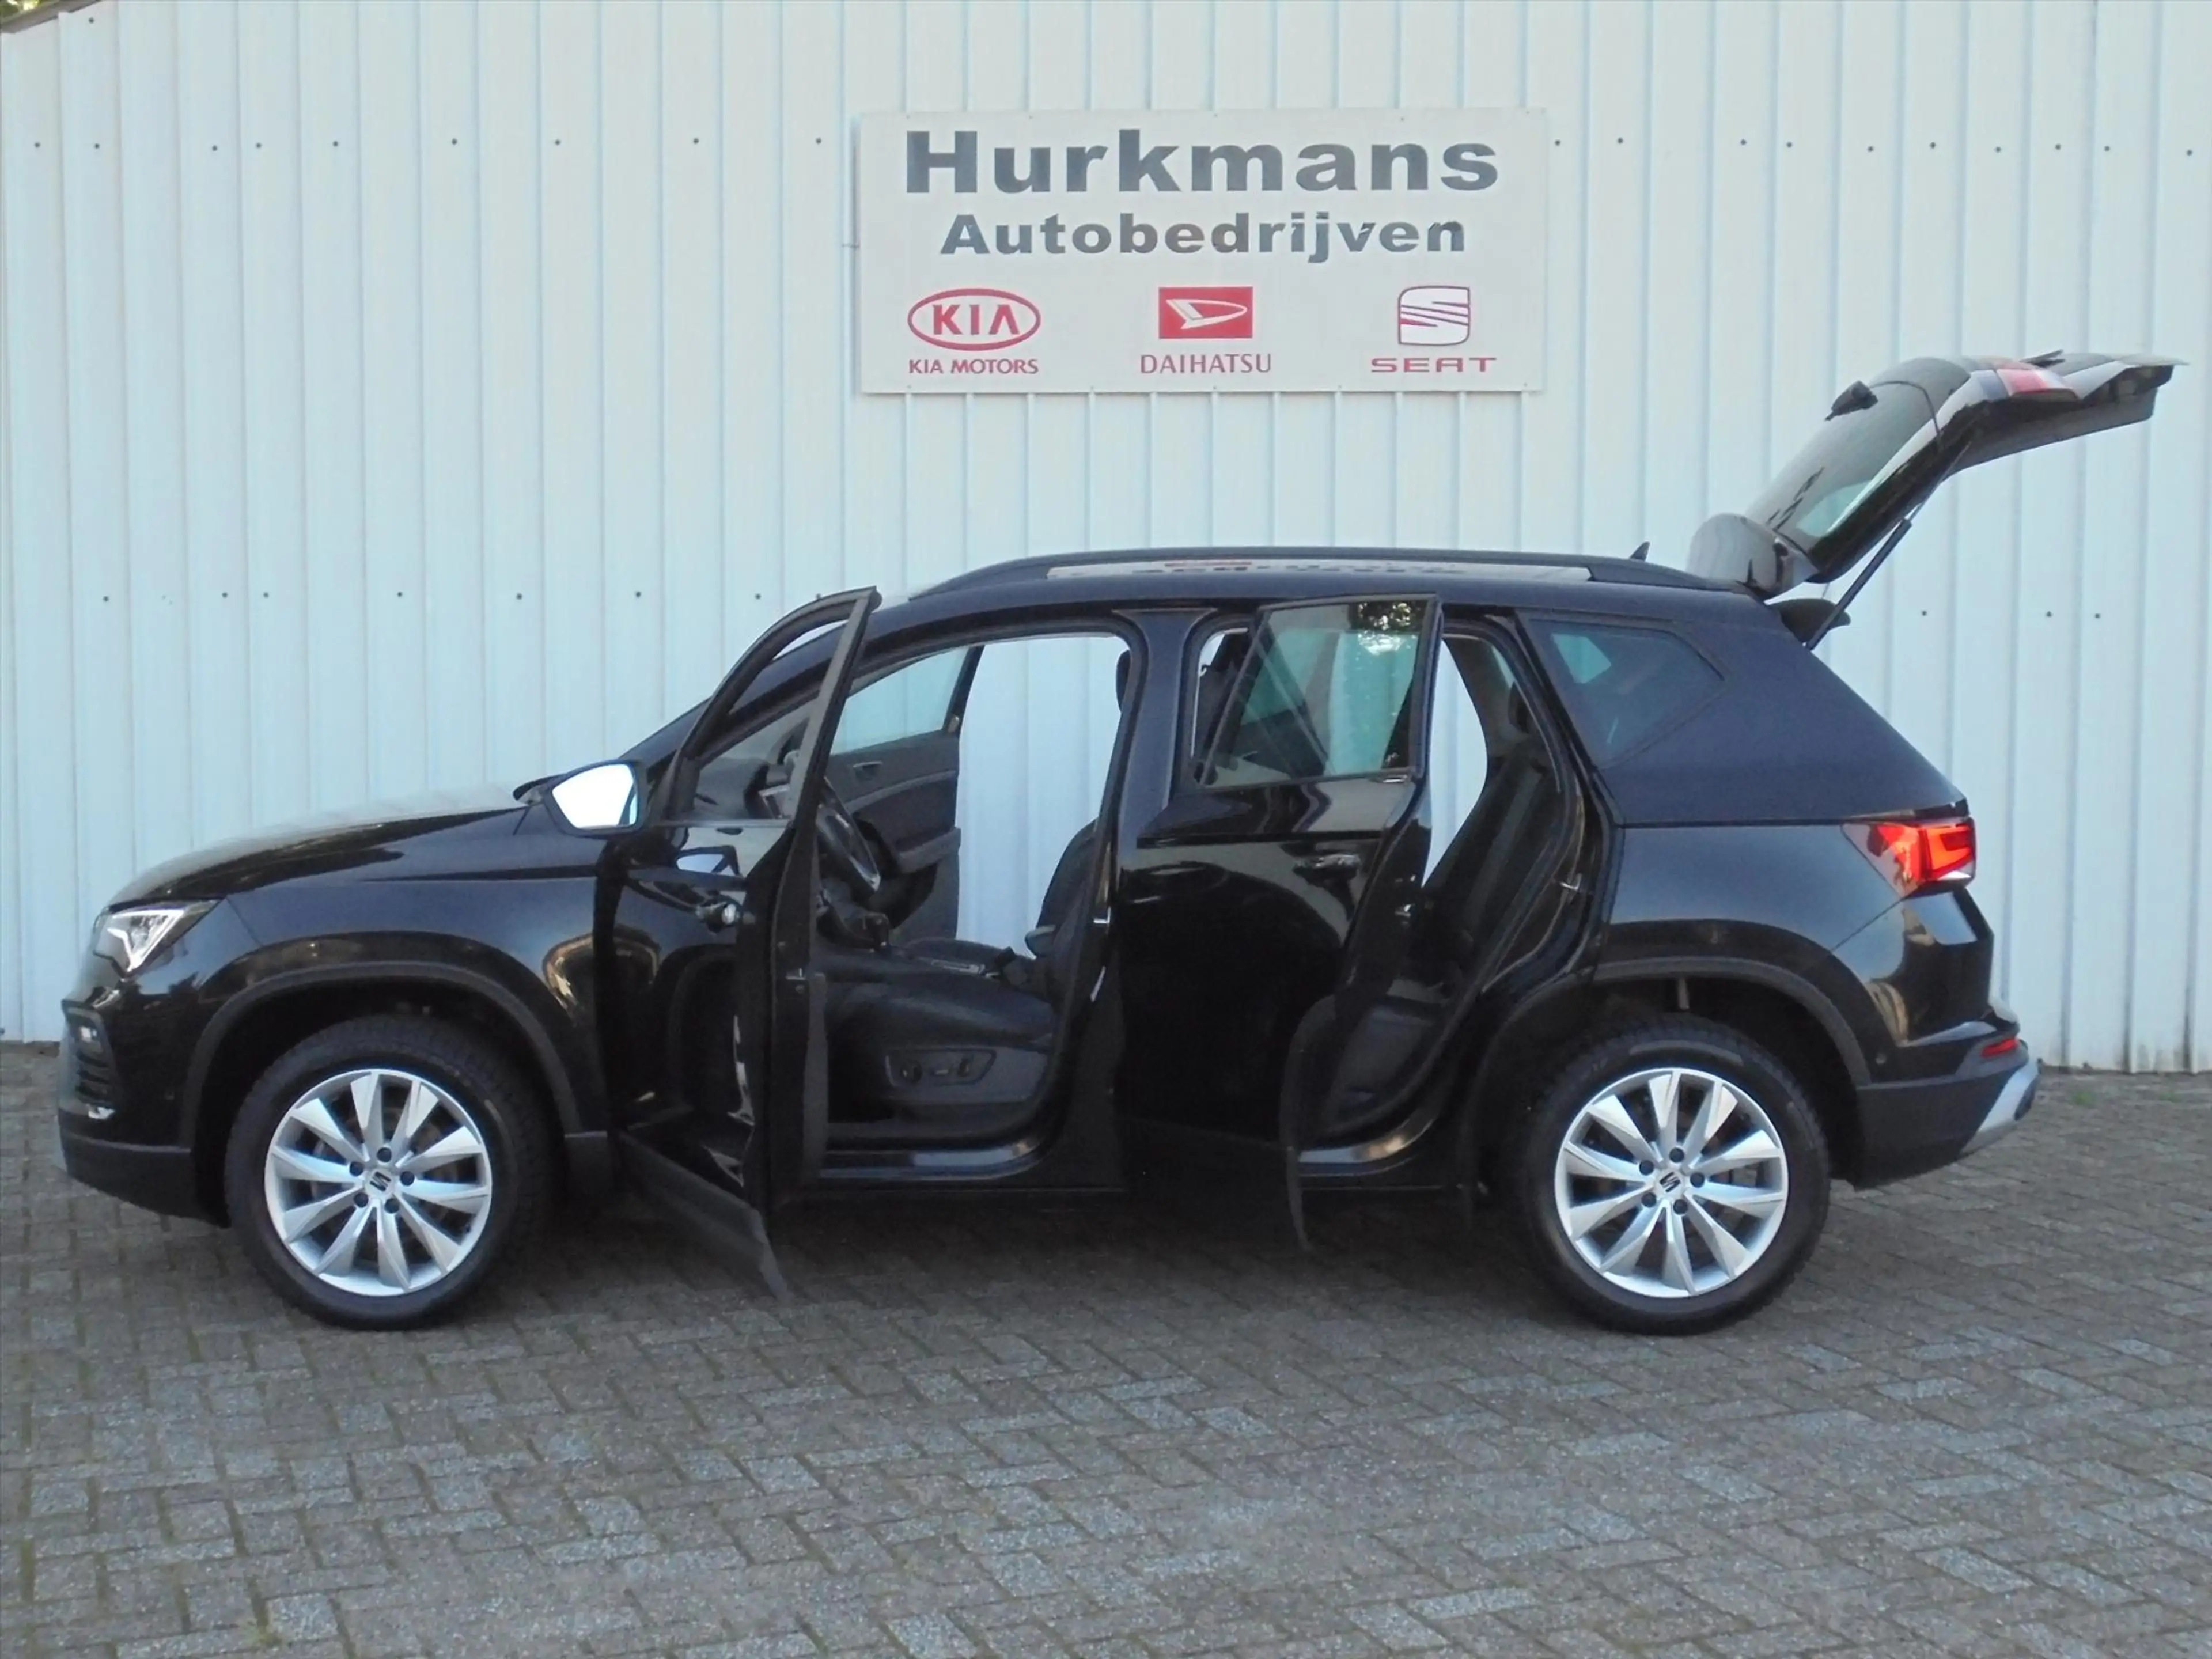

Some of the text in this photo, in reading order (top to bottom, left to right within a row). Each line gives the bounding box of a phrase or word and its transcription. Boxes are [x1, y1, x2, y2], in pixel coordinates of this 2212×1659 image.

[907, 129, 1497, 194] Hurkmans
[940, 212, 1464, 263] Autobedrijven
[933, 304, 1020, 335] KIA
[909, 358, 1039, 374] KIA MOTORS
[1141, 354, 1271, 374] DAIHATSU
[1371, 358, 1497, 373] SEAT
